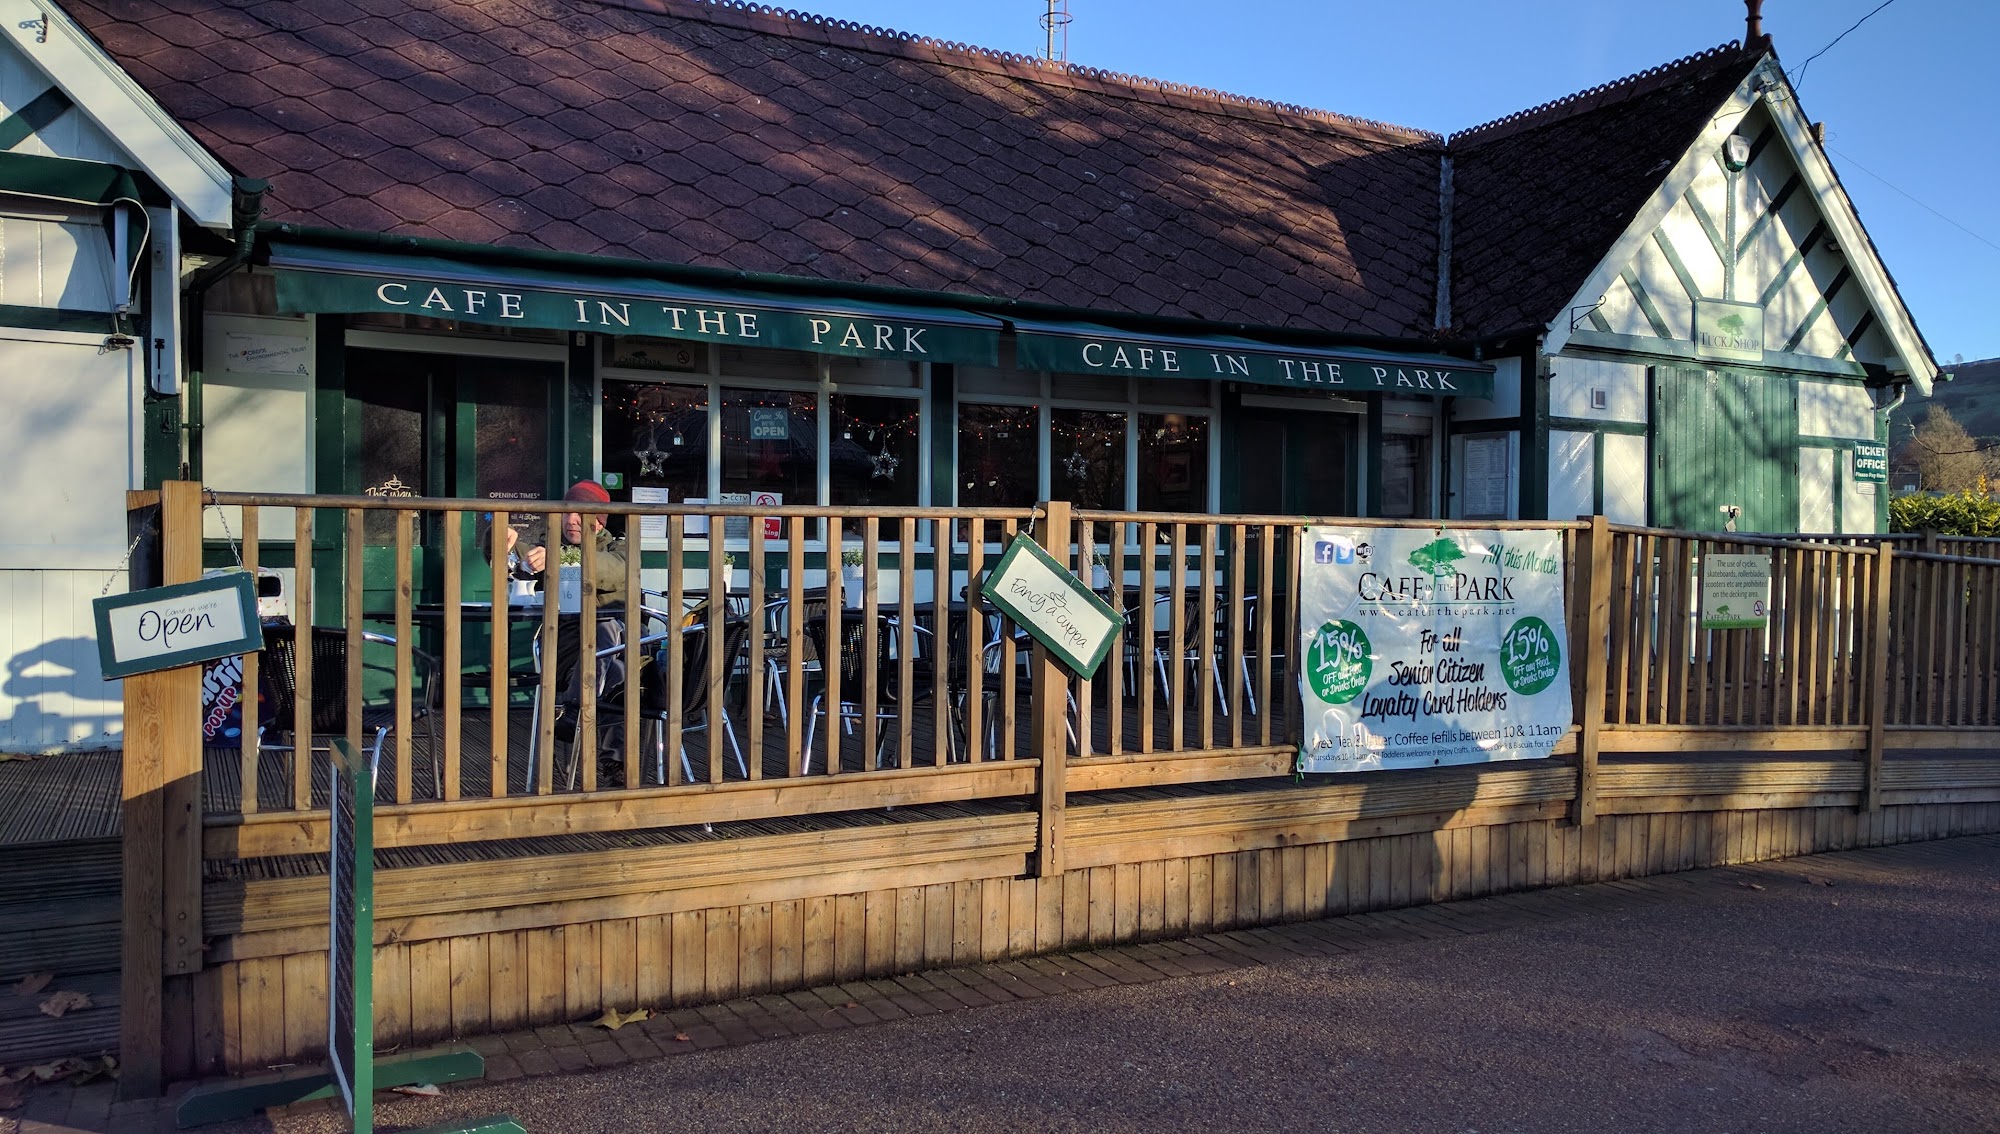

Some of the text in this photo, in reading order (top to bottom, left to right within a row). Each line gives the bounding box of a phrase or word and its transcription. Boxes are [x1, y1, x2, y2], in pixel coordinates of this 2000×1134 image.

[376, 283, 928, 353] CAFE IN THE PARK
[1082, 343, 1457, 390] CAFE IN THE PARK
[753, 426, 785, 437] OPEN
[1856, 445, 1886, 457] TICKET
[1856, 458, 1886, 470] OFFICE
[489, 491, 519, 499] OPENING
[1482, 543, 1558, 575] All this Month
[1358, 572, 1424, 601] CAFE
[1454, 572, 1515, 601] PARK
[1720, 590, 1728, 598] the
[1728, 590, 1748, 599] decking
[165, 608, 187, 617] Come
[1009, 577, 1089, 649] Fancy a cuppa
[138, 610, 216, 648] Open
[1420, 626, 1462, 655] For all
[1313, 629, 1363, 673] 15%
[1504, 624, 1549, 666] 15%
[1323, 671, 1338, 685] OFF
[1388, 657, 1485, 686] Senior Citizen
[1513, 663, 1525, 677] OFF
[203, 686, 238, 737] POP UP
[1361, 685, 1508, 724] Loyalty Card Holders
[1381, 750, 1406, 759] Toddlers
[1406, 749, 1432, 757] welcome
[1437, 749, 1454, 757] enjoy
[1534, 740, 1544, 748] for
[1394, 731, 1429, 746] Coffee
[1459, 727, 1501, 742] between
[1503, 725, 1515, 738] 10
[1516, 724, 1525, 738] &
[1528, 724, 1562, 737] 11am
